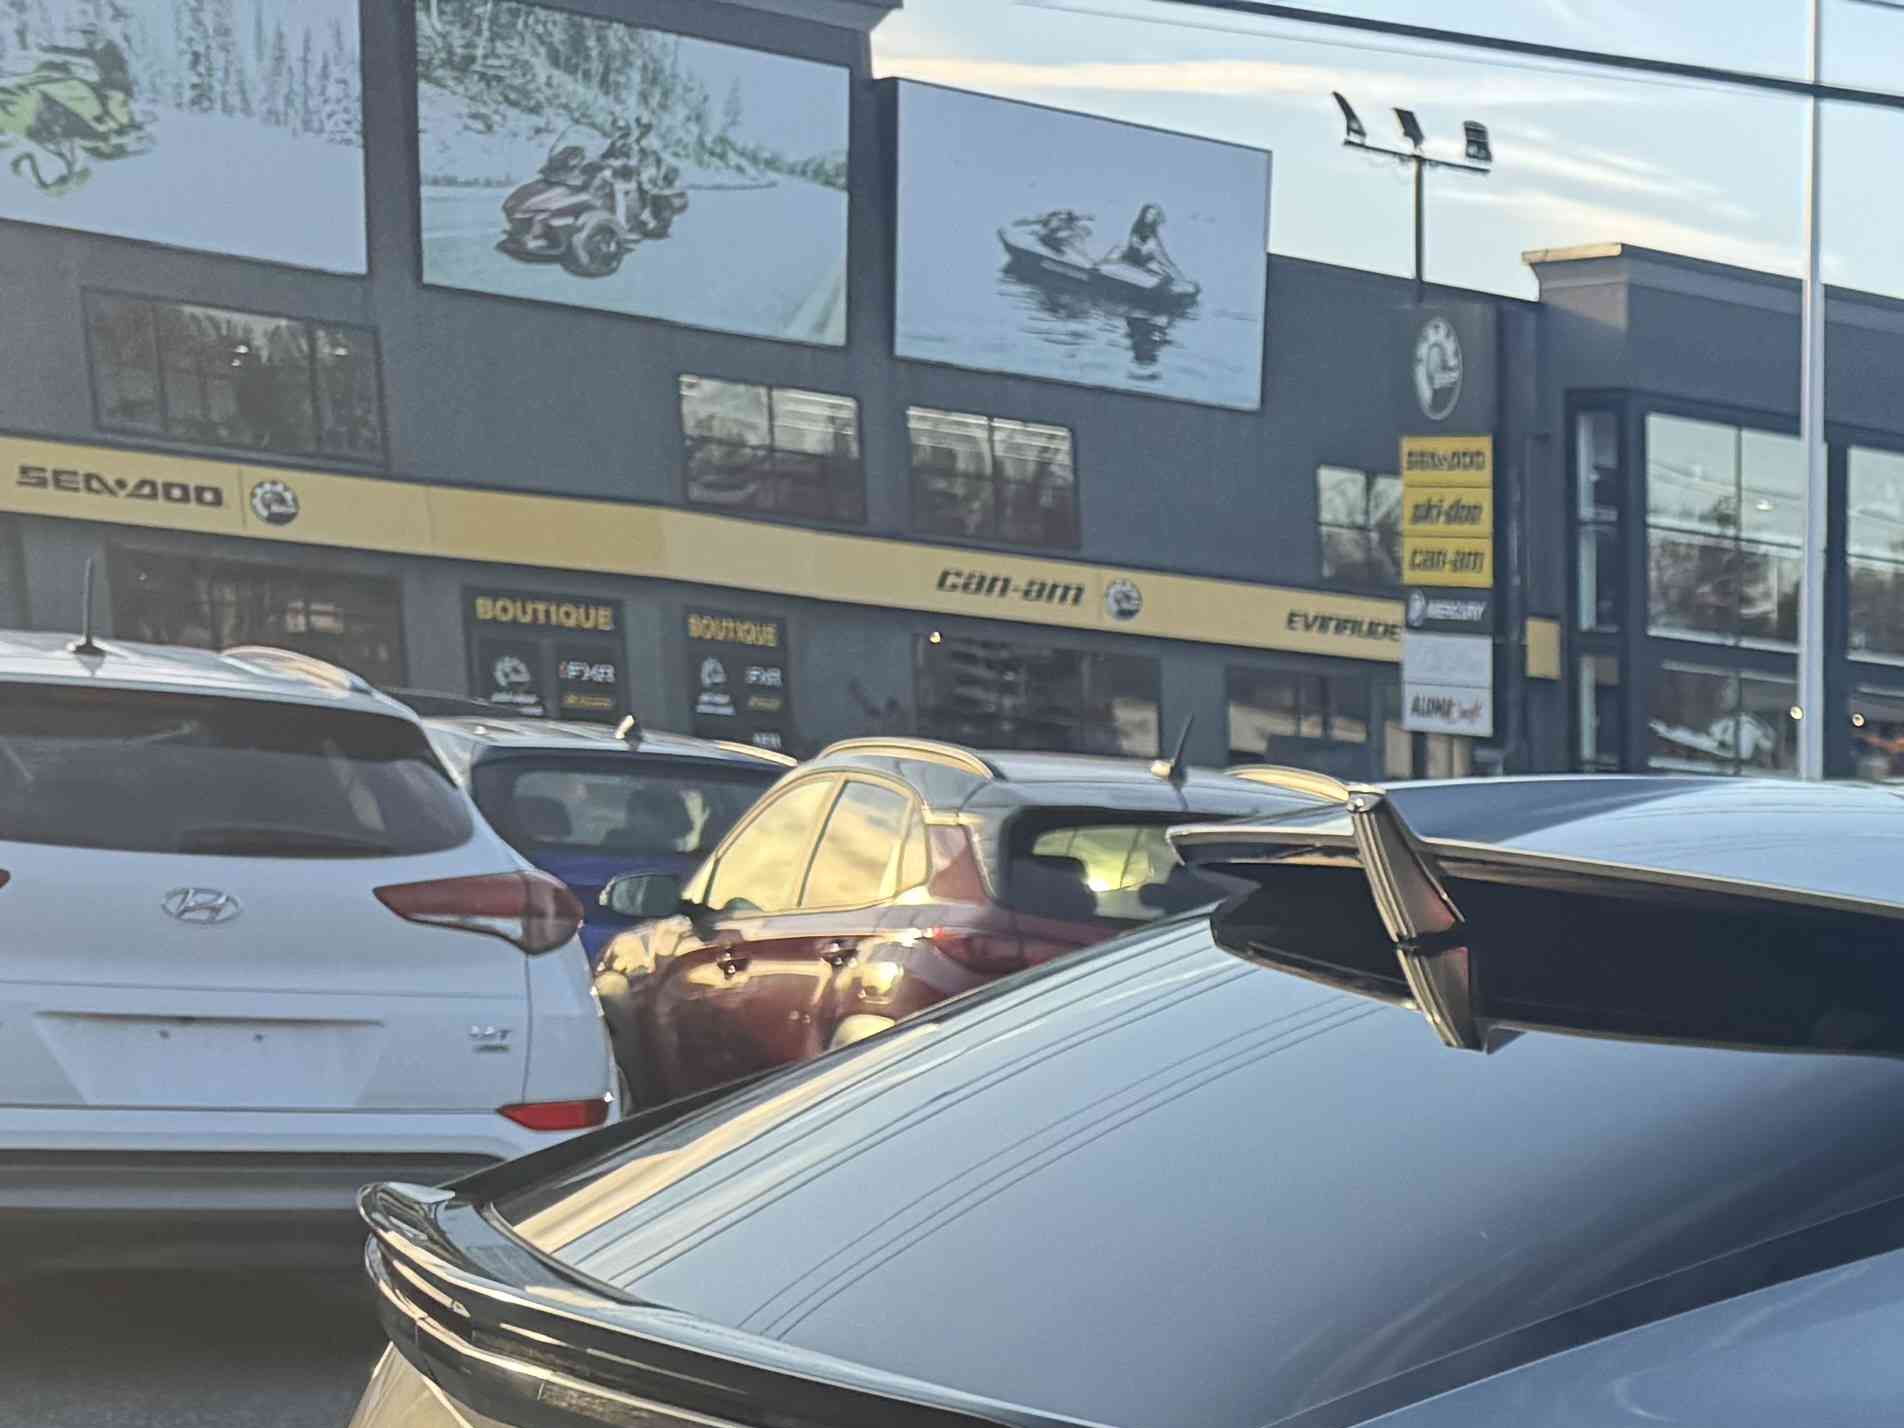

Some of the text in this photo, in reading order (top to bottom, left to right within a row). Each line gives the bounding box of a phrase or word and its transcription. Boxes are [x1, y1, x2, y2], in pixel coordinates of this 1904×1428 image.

[936, 568, 1085, 607] can-am
[476, 596, 613, 631] BOUTIQUE
[688, 613, 777, 648] BOUTIQUE
